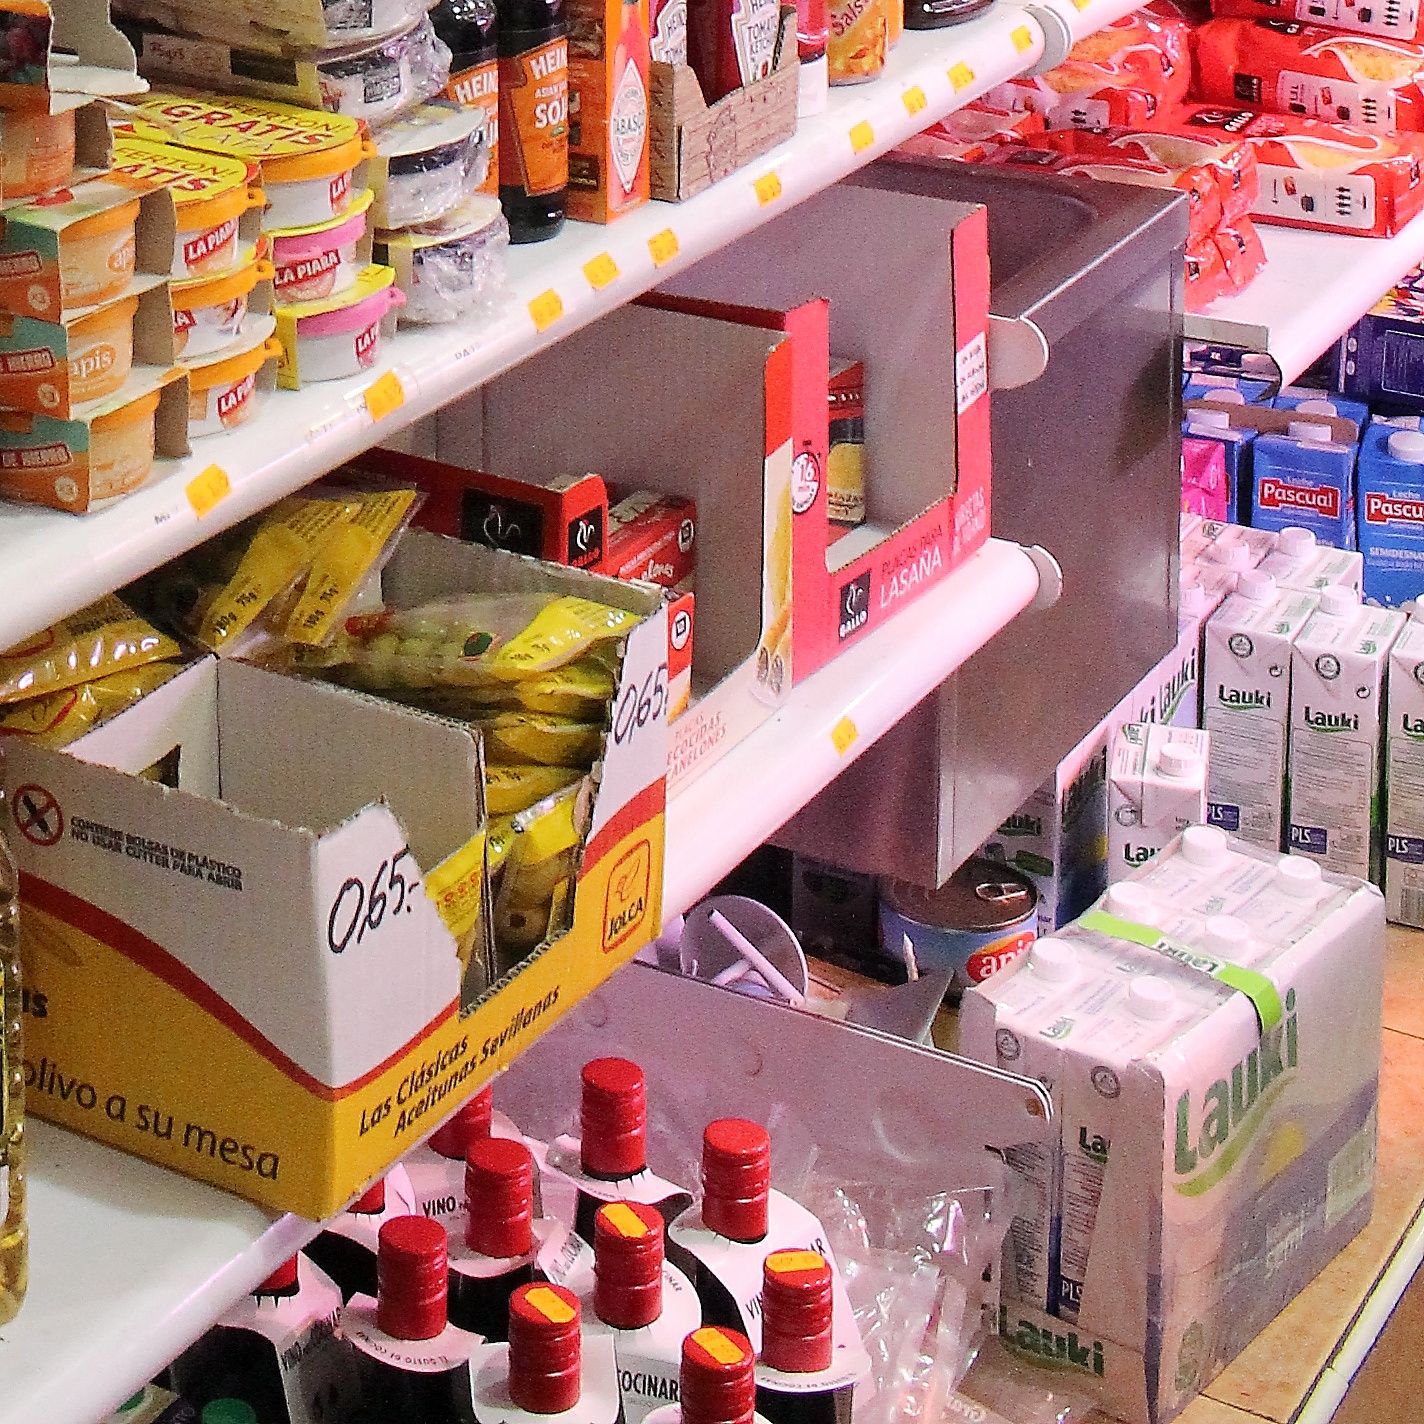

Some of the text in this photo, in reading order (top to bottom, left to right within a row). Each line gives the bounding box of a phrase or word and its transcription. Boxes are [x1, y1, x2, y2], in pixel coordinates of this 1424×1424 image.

[1262, 483, 1334, 509] Pascual
[880, 545, 943, 609] LASAÑA
[840, 611, 868, 638] GALLO
[1218, 684, 1272, 709] Lauki
[1305, 706, 1359, 731] Lauki
[1291, 827, 1312, 843] PLS
[1388, 837, 1410, 852] PLS
[608, 896, 645, 942] JOLCA
[394, 982, 560, 1137] Aceitunas Sevillanas
[358, 1033, 469, 1137] Las Clásicas
[1174, 987, 1298, 1176] Lauki
[24, 1055, 97, 1110] olivo
[105, 1098, 127, 1122] a
[135, 1105, 174, 1143] su
[182, 1120, 280, 1181] mesa
[422, 1197, 456, 1218] VINO
[1000, 1306, 1106, 1376] Lauki
